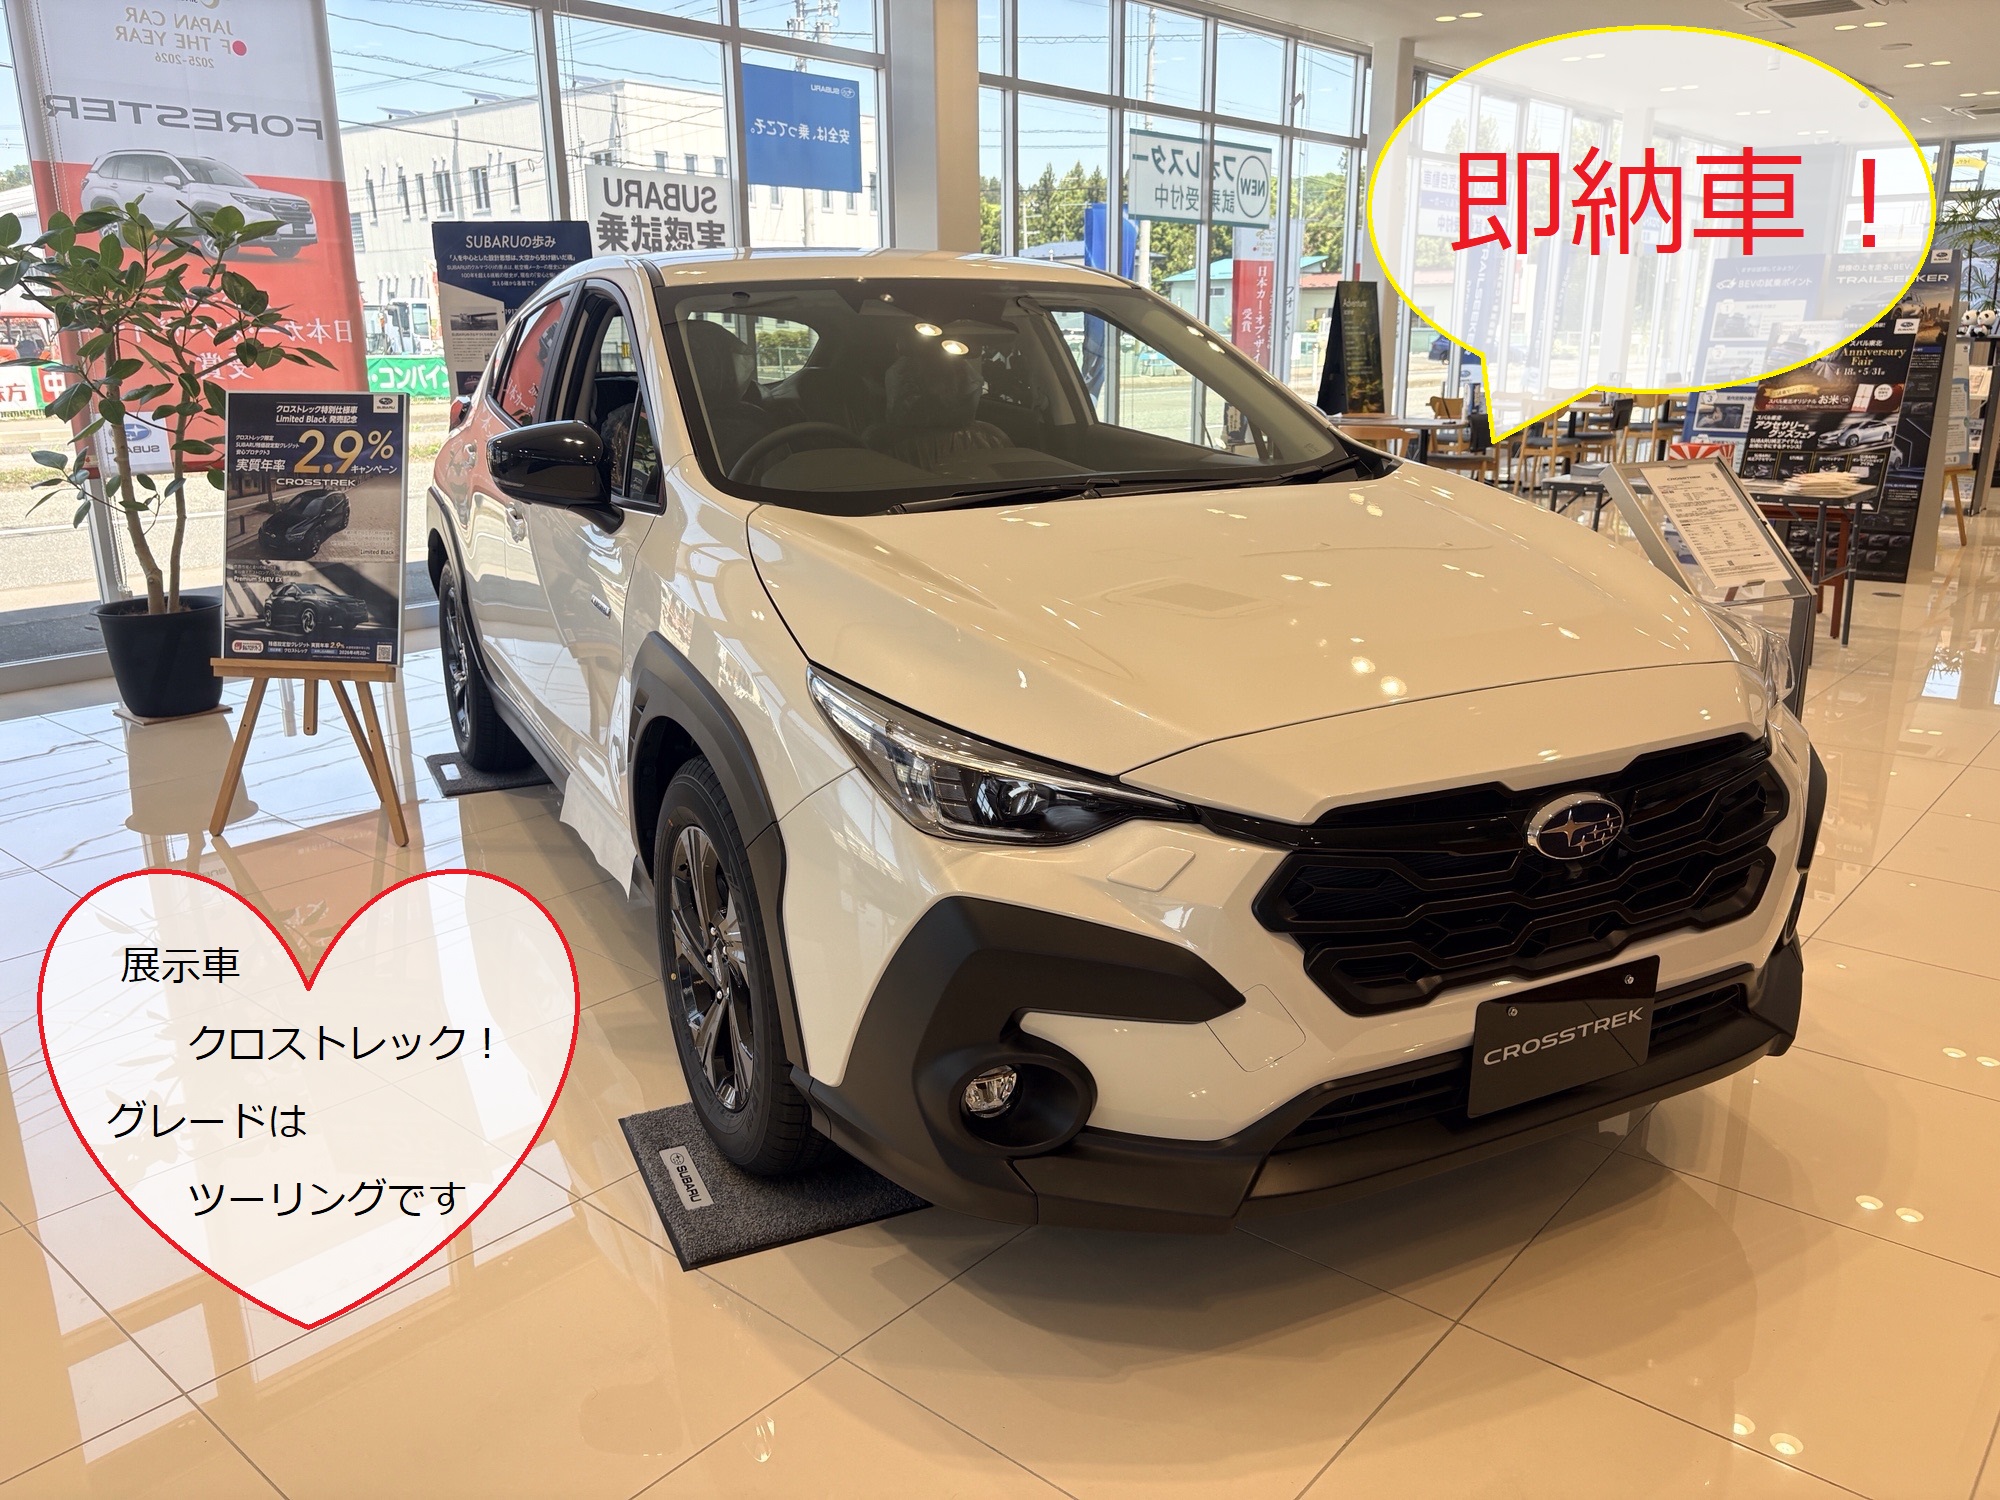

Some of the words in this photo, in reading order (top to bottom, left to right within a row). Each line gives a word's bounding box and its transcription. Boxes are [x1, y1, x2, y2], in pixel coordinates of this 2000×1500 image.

[465, 235, 557, 249] SUBARUの歩み
[1241, 308, 1254, 333] 受賞
[1842, 347, 1907, 358] Anniversary
[1851, 356, 1874, 366] Fair
[1818, 394, 1840, 405] お米
[276, 405, 358, 414] クロストレック特別仕様車
[276, 415, 304, 423] Limited
[306, 415, 327, 423] Black
[329, 415, 358, 424] 発売記念
[1768, 429, 1816, 439] グッズフェア
[235, 458, 286, 472] 実質年率
[293, 429, 395, 474] 2.9%
[351, 465, 398, 474] キャンペーン
[276, 477, 357, 487] CROSSTREK
[1483, 1006, 1643, 1066] CROSSTREK
[676, 1165, 702, 1203] SUBARU
